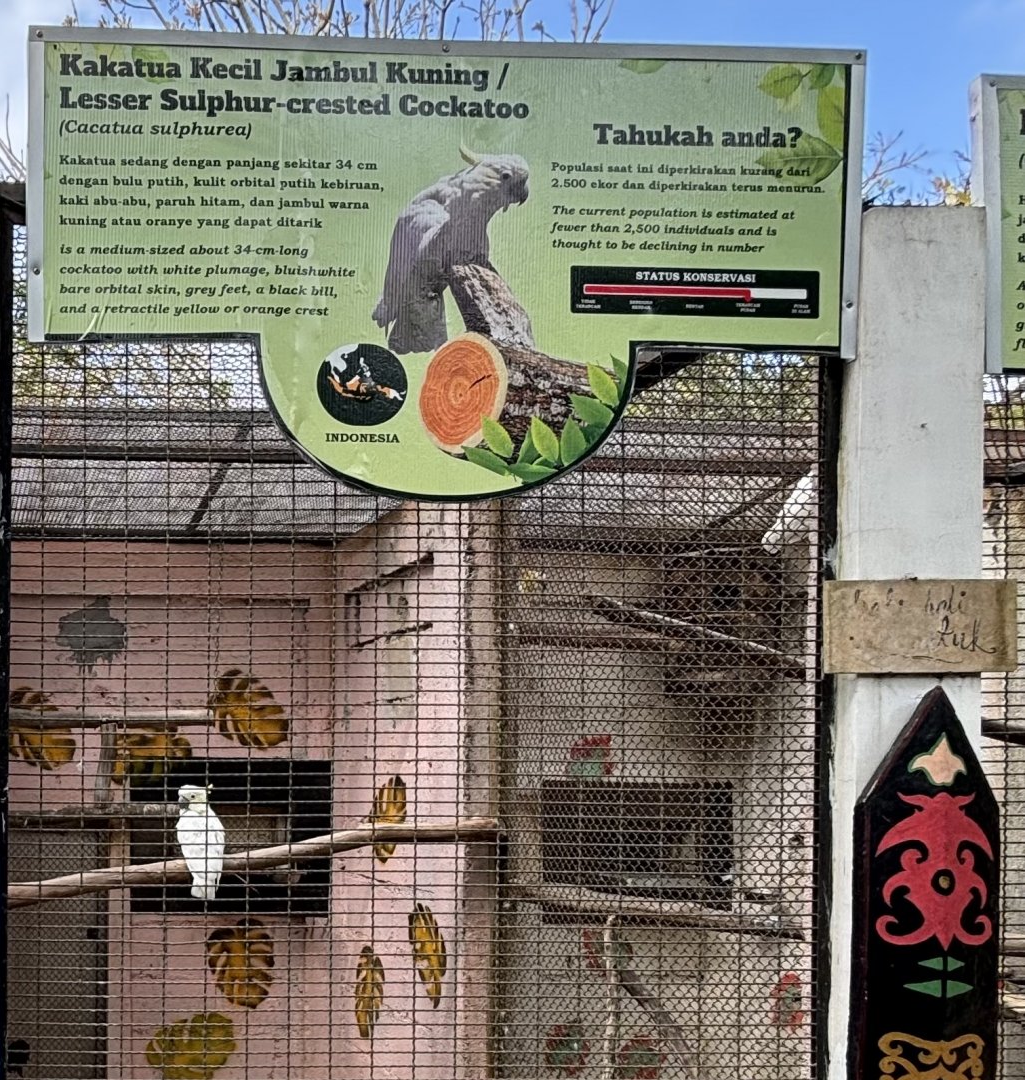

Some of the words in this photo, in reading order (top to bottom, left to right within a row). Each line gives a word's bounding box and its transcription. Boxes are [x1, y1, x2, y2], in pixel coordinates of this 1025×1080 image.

[59, 52, 181, 80] Kakatua
[189, 56, 262, 80] Kecil
[270, 59, 377, 83] Jambul
[385, 61, 489, 92] Kuning
[496, 62, 509, 90] /
[59, 86, 152, 110] Lesser
[160, 88, 390, 117] Sulphur-crested
[398, 93, 529, 119] Cockatoo
[59, 119, 143, 137] (Cacatua
[149, 121, 251, 140] sulphurea)
[593, 123, 713, 146] Tahukah
[721, 126, 804, 149] anda?
[59, 154, 115, 166] Kakatua
[120, 155, 168, 169] sedang
[172, 156, 221, 170] dengan
[226, 157, 279, 171] panjang
[283, 158, 331, 169] sekitar
[335, 159, 352, 170] 34
[357, 162, 377, 170] cm
[551, 161, 603, 174] Populasi
[607, 164, 632, 173] saat
[636, 163, 653, 173] ini
[657, 163, 735, 176] diperkirakan
[740, 163, 783, 178] kurang
[786, 166, 814, 176] dari
[551, 177, 586, 188] 2.500
[590, 178, 618, 189] ekor
[622, 179, 645, 190] dan
[648, 180, 727, 193] diperkirakan
[731, 182, 763, 192] terus
[766, 184, 825, 193] menurun.
[552, 205, 575, 215] The
[578, 207, 625, 216] current
[628, 207, 697, 219] population
[701, 208, 712, 218] is
[715, 208, 778, 219] estimated
[781, 210, 794, 220] at
[59, 214, 107, 228] kuning
[111, 216, 141, 226] atau
[145, 218, 192, 229] oranye
[196, 218, 229, 229] yang
[234, 215, 272, 229] dapat
[276, 216, 322, 228] ditarik
[549, 221, 587, 234] fewer
[590, 222, 619, 233] than
[623, 223, 660, 235] 2,500
[664, 224, 734, 235] individuals
[737, 226, 762, 236] and
[766, 226, 776, 236] is
[60, 243, 72, 254] is
[76, 246, 85, 254] a
[90, 244, 185, 255] medium-sized
[189, 244, 229, 255] about
[552, 238, 601, 251] thought
[605, 240, 617, 249] to
[621, 239, 635, 250] be
[638, 240, 697, 254] declining
[701, 241, 713, 252] in
[717, 242, 764, 252] number
[59, 263, 122, 274] cockatoo
[127, 264, 158, 274] with
[163, 264, 201, 275] white
[204, 264, 269, 278] plumage,
[635, 271, 680, 281] STATUS
[683, 272, 755, 283] KONSERVASI
[325, 432, 399, 443] INDONESIA
